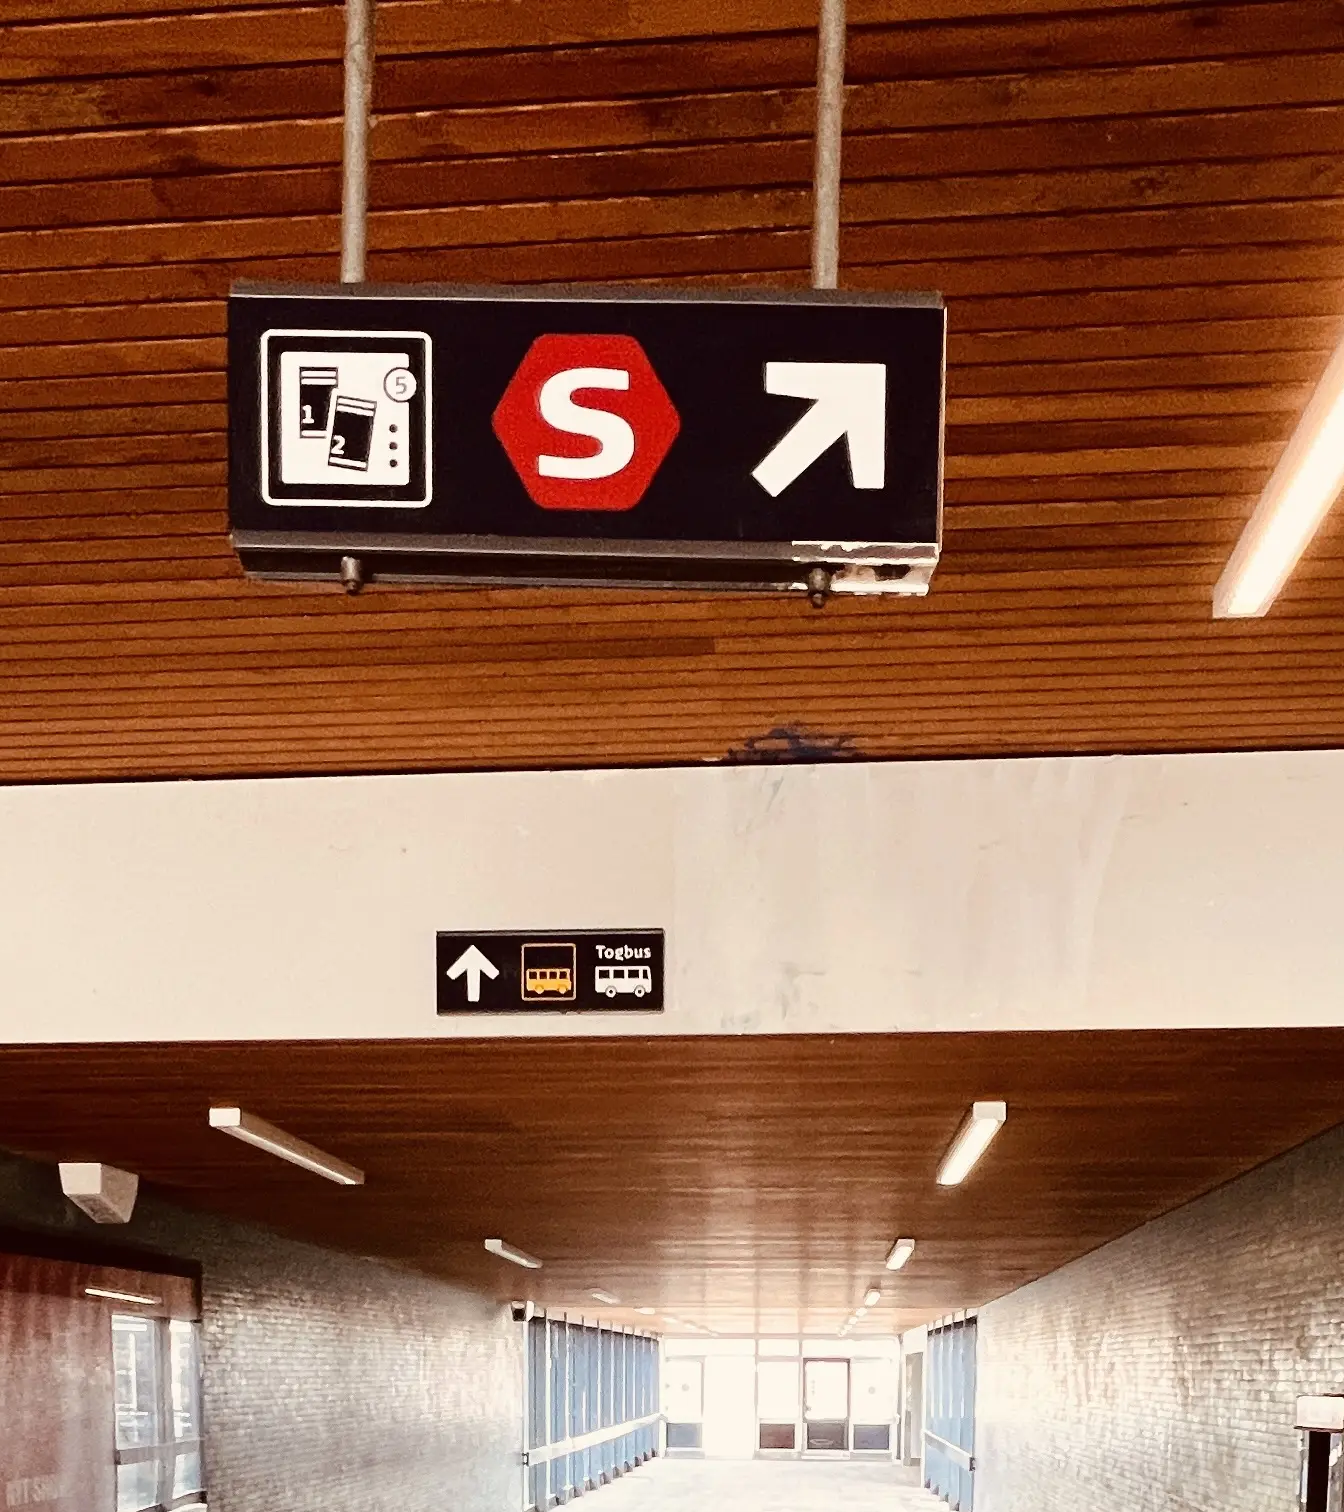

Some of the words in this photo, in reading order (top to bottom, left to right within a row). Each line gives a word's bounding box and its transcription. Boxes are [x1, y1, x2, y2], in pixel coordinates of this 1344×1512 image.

[395, 376, 408, 395] 5
[301, 404, 315, 424] 1
[535, 367, 636, 480] S
[331, 435, 346, 456] 2
[595, 944, 652, 961] Togbus
